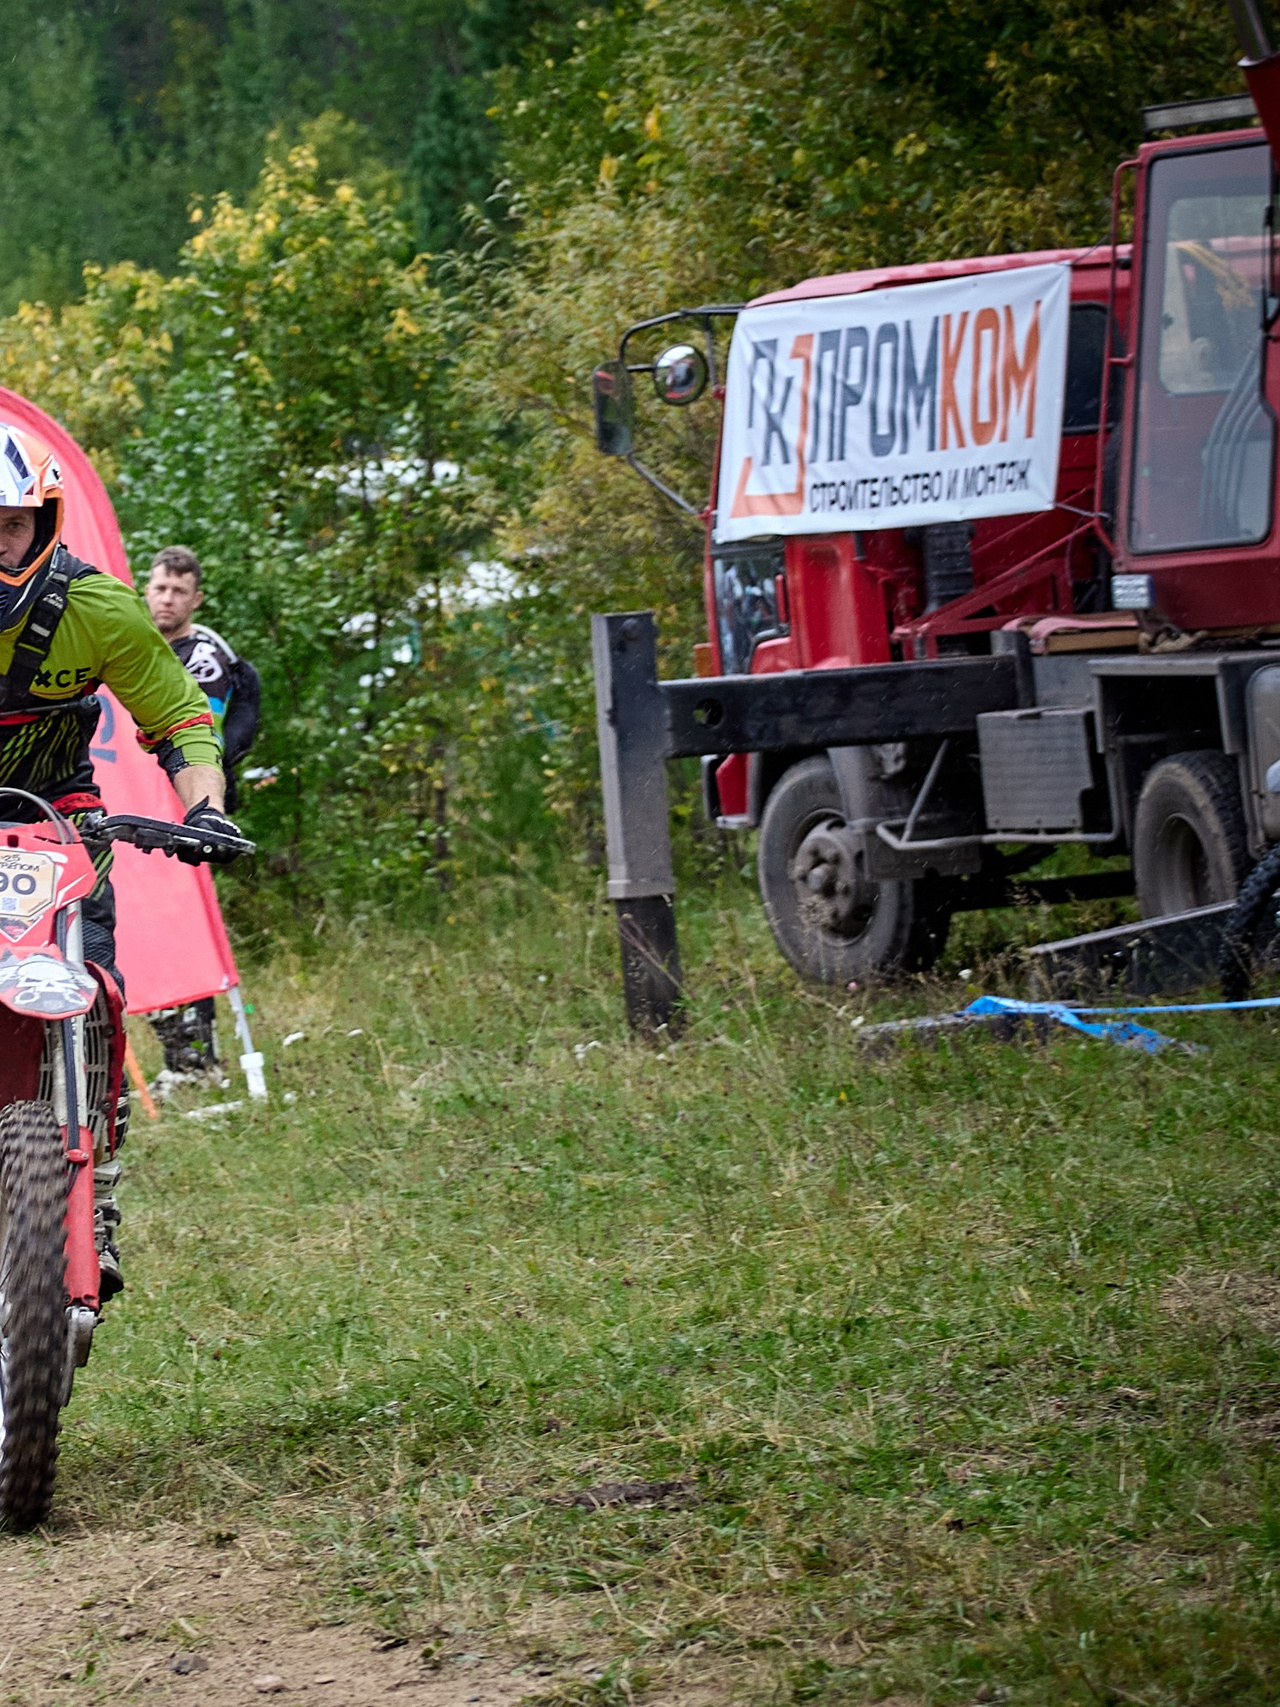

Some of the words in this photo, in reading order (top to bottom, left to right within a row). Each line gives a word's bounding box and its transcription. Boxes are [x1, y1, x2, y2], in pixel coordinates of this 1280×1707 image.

[808, 300, 1042, 464] ПРОМКОМ
[809, 469, 942, 513] СТРОИТЕЛЬСТВО
[946, 468, 959, 501] И
[962, 458, 1032, 498] МОНТАЖ
